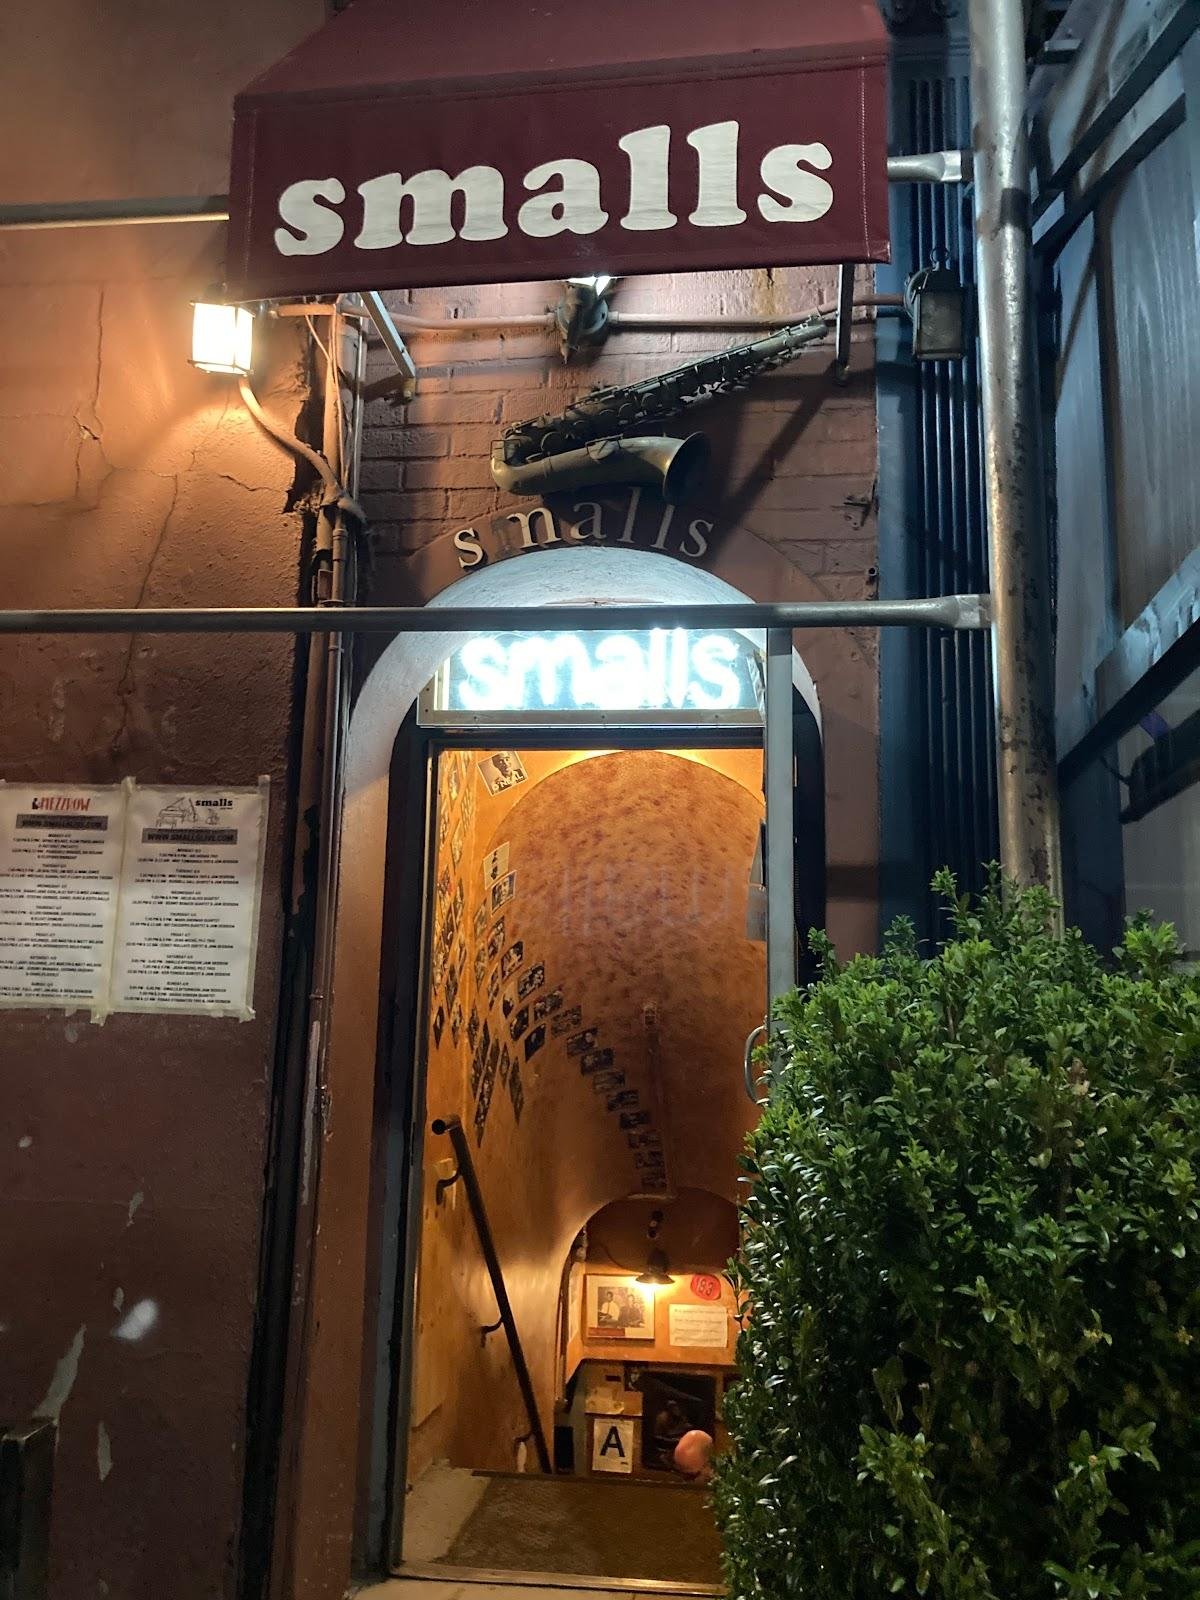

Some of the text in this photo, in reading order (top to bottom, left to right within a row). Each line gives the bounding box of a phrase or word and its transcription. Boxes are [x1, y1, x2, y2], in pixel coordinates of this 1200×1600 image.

[274, 120, 833, 256] smalls
[458, 628, 741, 710] smalls
[195, 798, 233, 807] smalls
[599, 1425, 625, 1458] A
